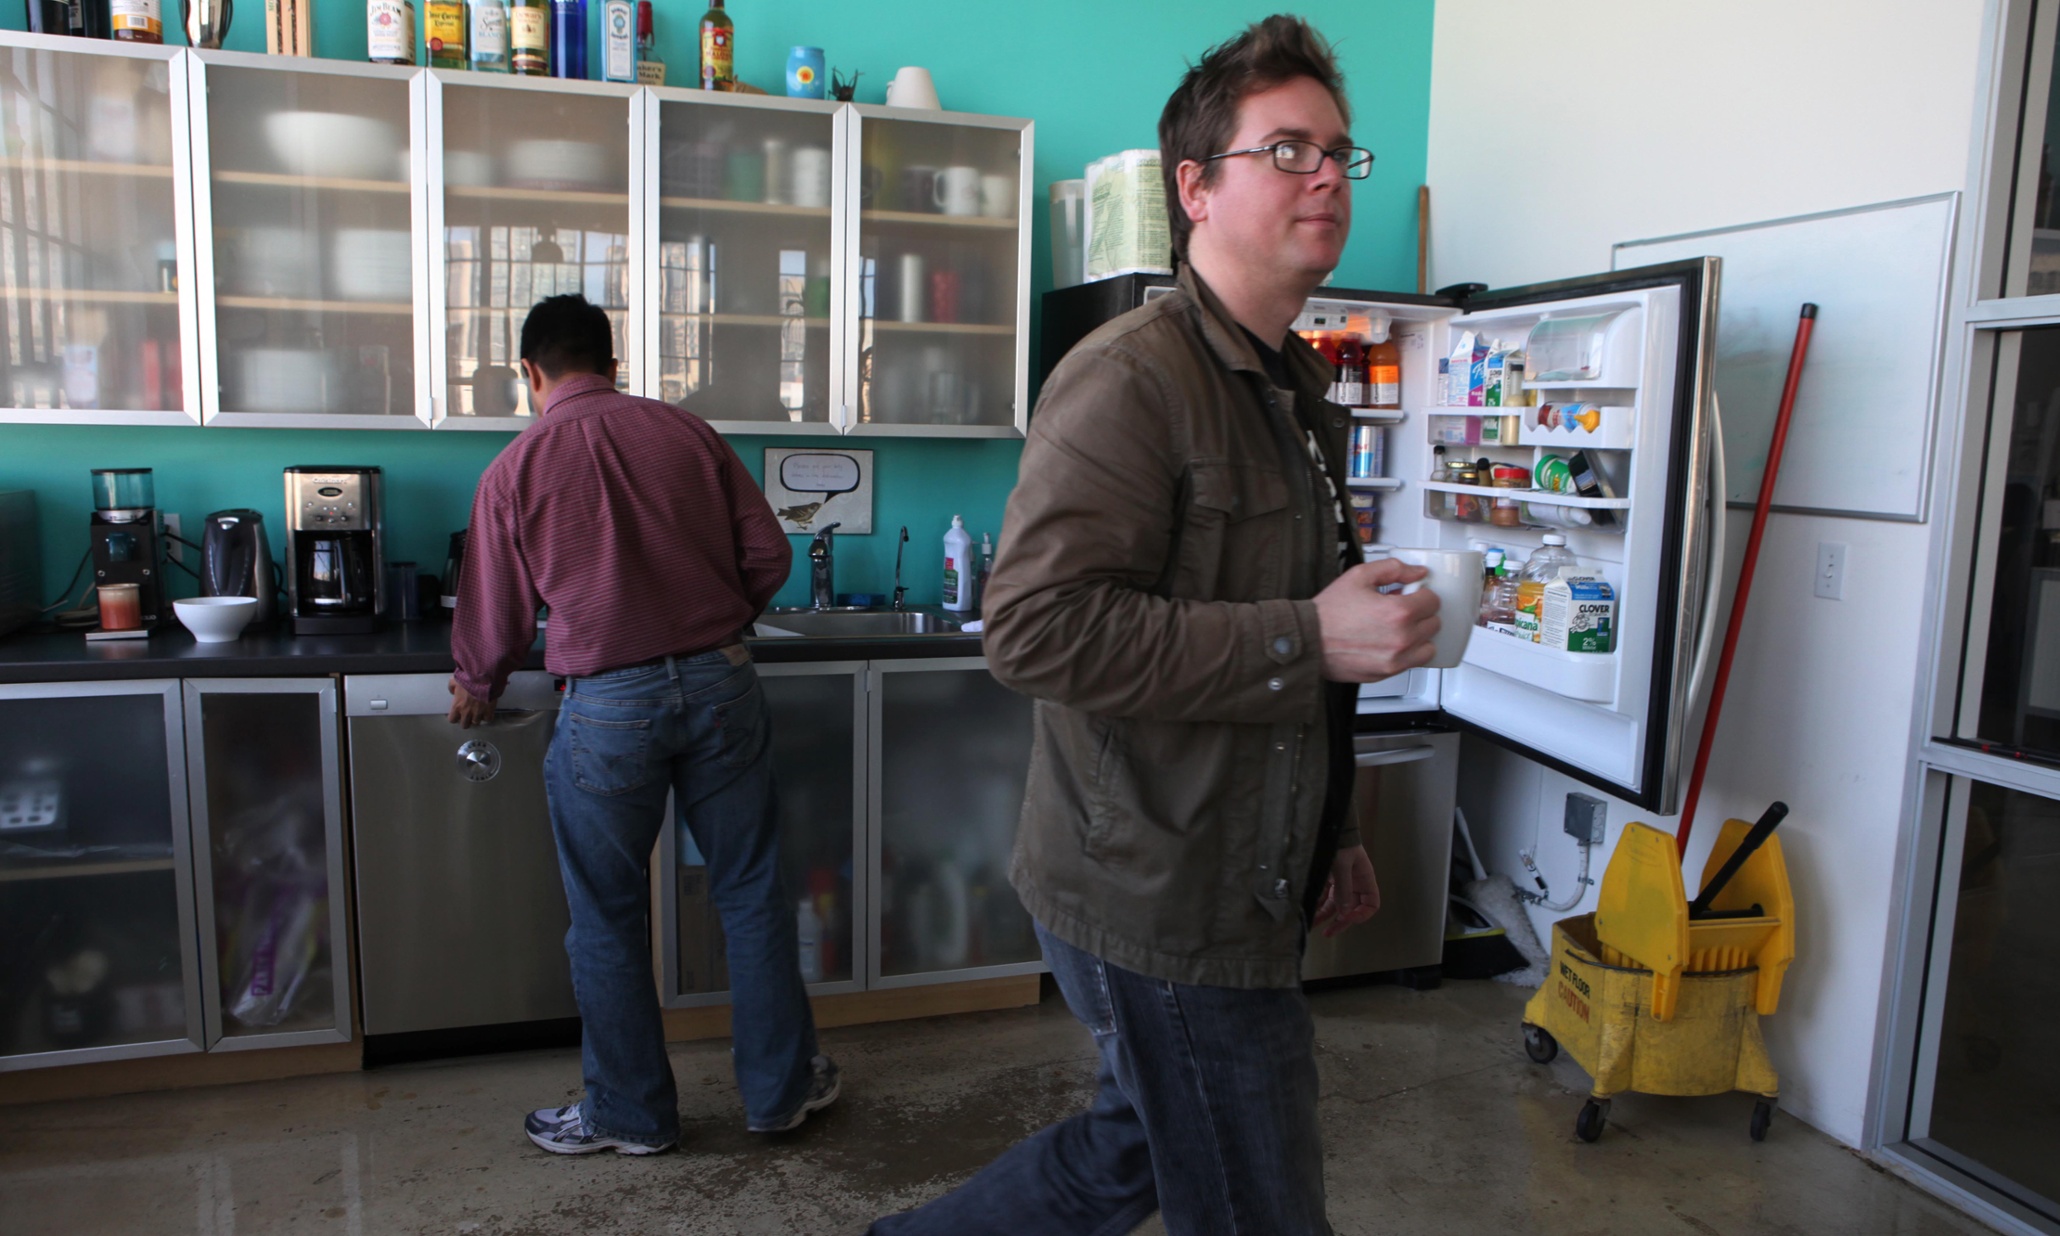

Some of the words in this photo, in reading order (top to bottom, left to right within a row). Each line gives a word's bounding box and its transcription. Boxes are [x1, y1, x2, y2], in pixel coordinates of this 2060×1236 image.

[638, 65, 662, 73] aker's
[1579, 604, 1610, 613] CLOVER
[1582, 638, 1597, 646] 2%
[1560, 960, 1572, 982] WET
[1572, 972, 1590, 999] FLOOR
[1558, 980, 1590, 1024] CAUTION
